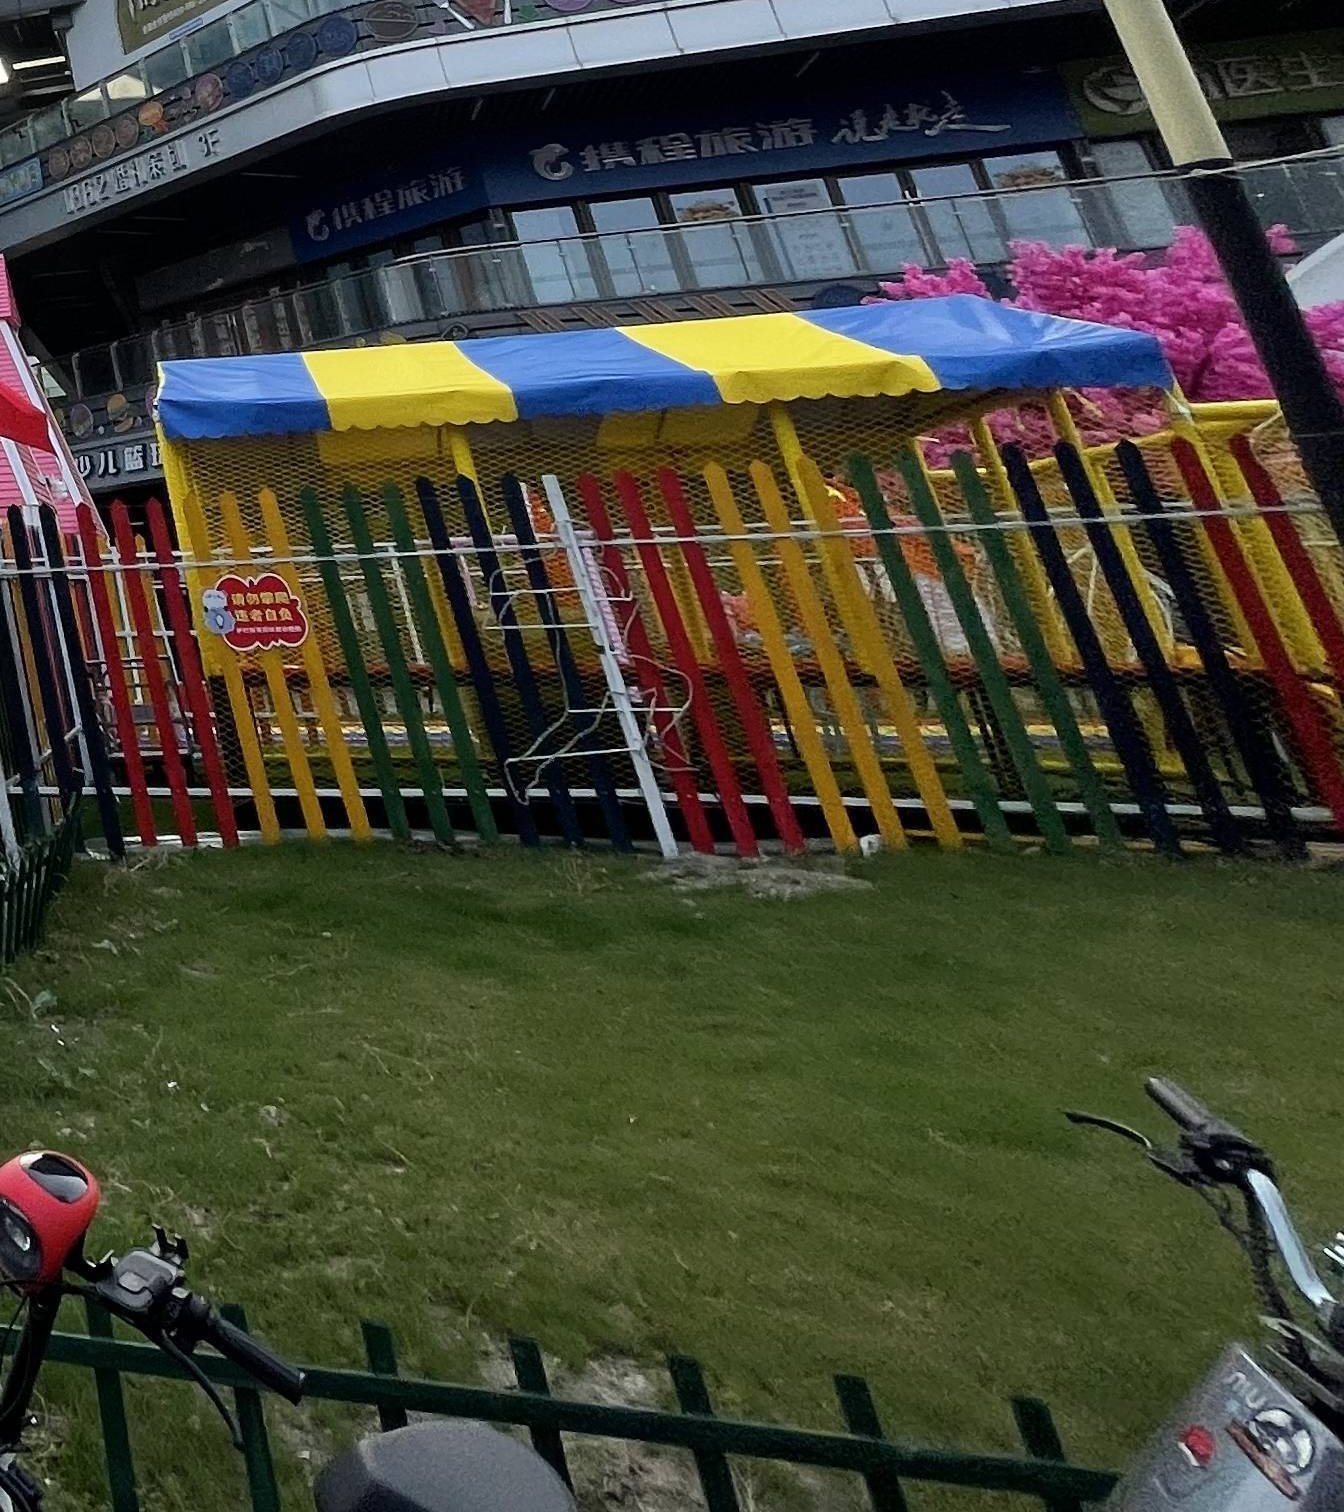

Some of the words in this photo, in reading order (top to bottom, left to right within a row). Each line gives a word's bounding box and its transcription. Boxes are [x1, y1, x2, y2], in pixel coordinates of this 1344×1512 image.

[576, 117, 814, 173] 携程旅游
[331, 167, 465, 234] 携程旅游
